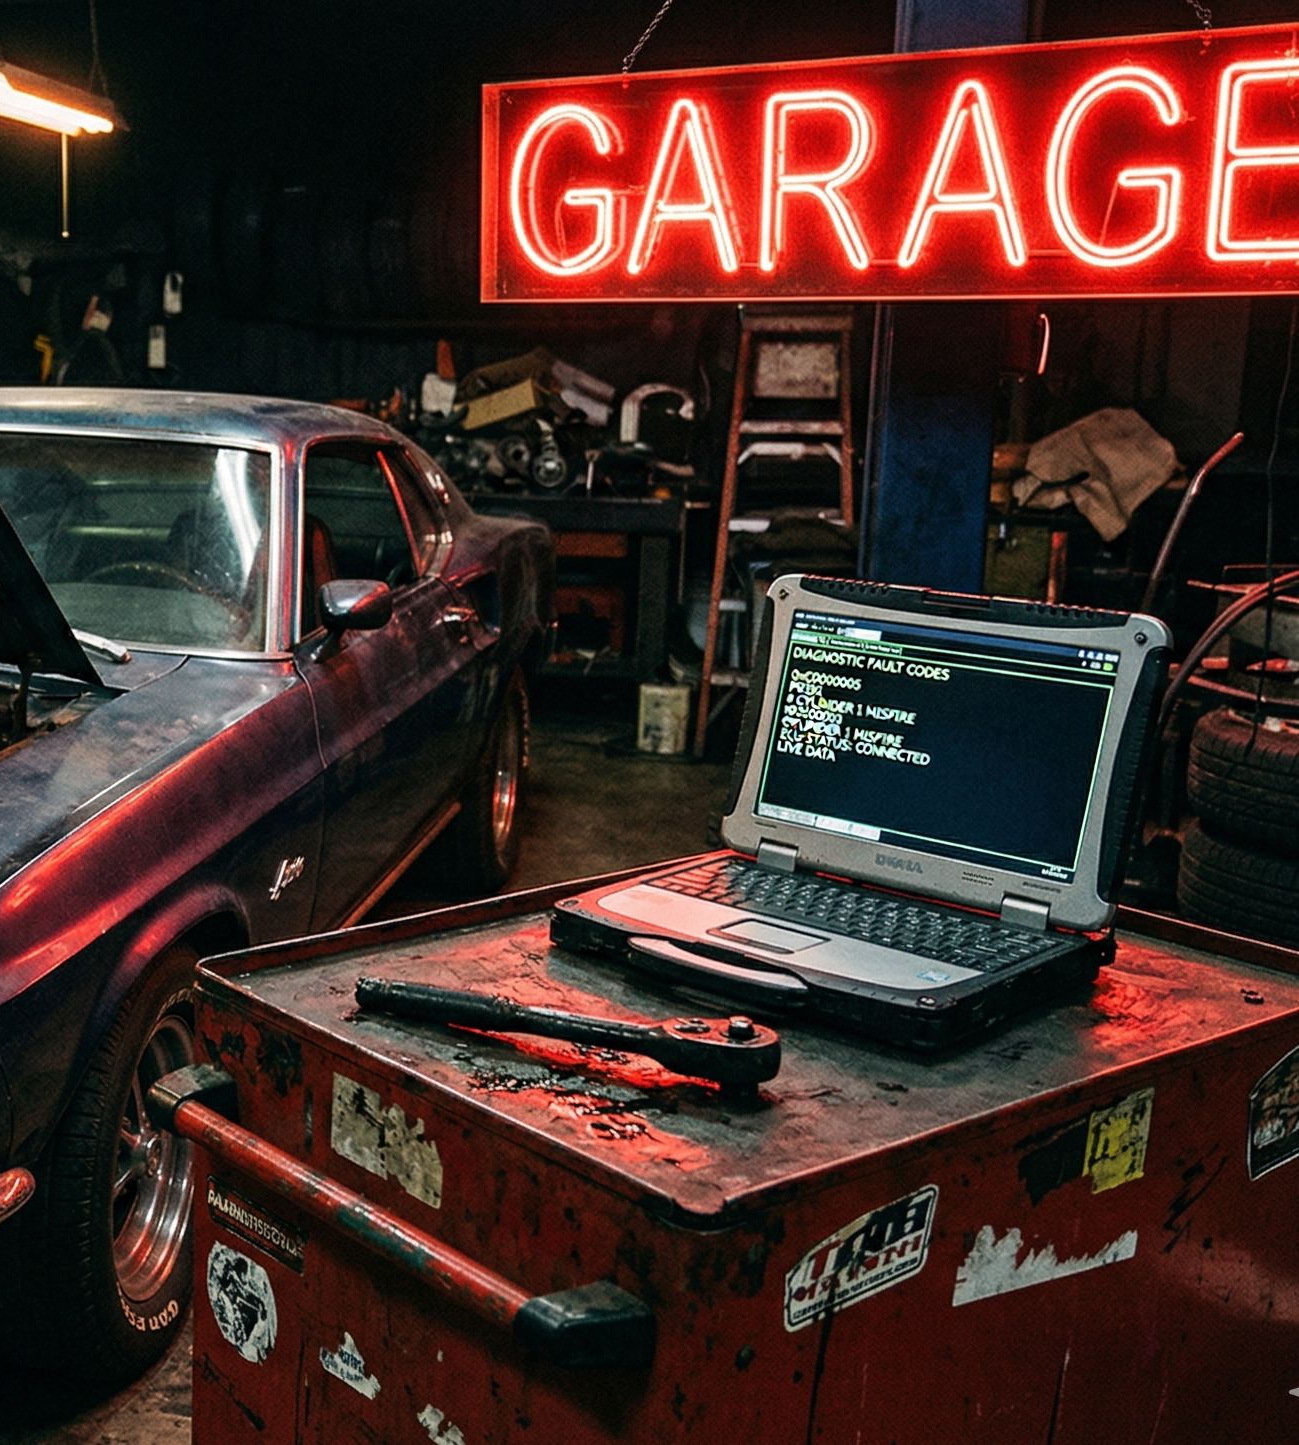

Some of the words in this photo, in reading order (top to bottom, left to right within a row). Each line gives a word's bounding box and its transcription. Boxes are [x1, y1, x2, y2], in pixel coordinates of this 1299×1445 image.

[510, 60, 1299, 276] GARAGE
[793, 646, 866, 669] DIAGNOSTIC
[866, 657, 905, 674] FAULT
[906, 664, 951, 681] CODES
[855, 741, 931, 766] CONNECTED
